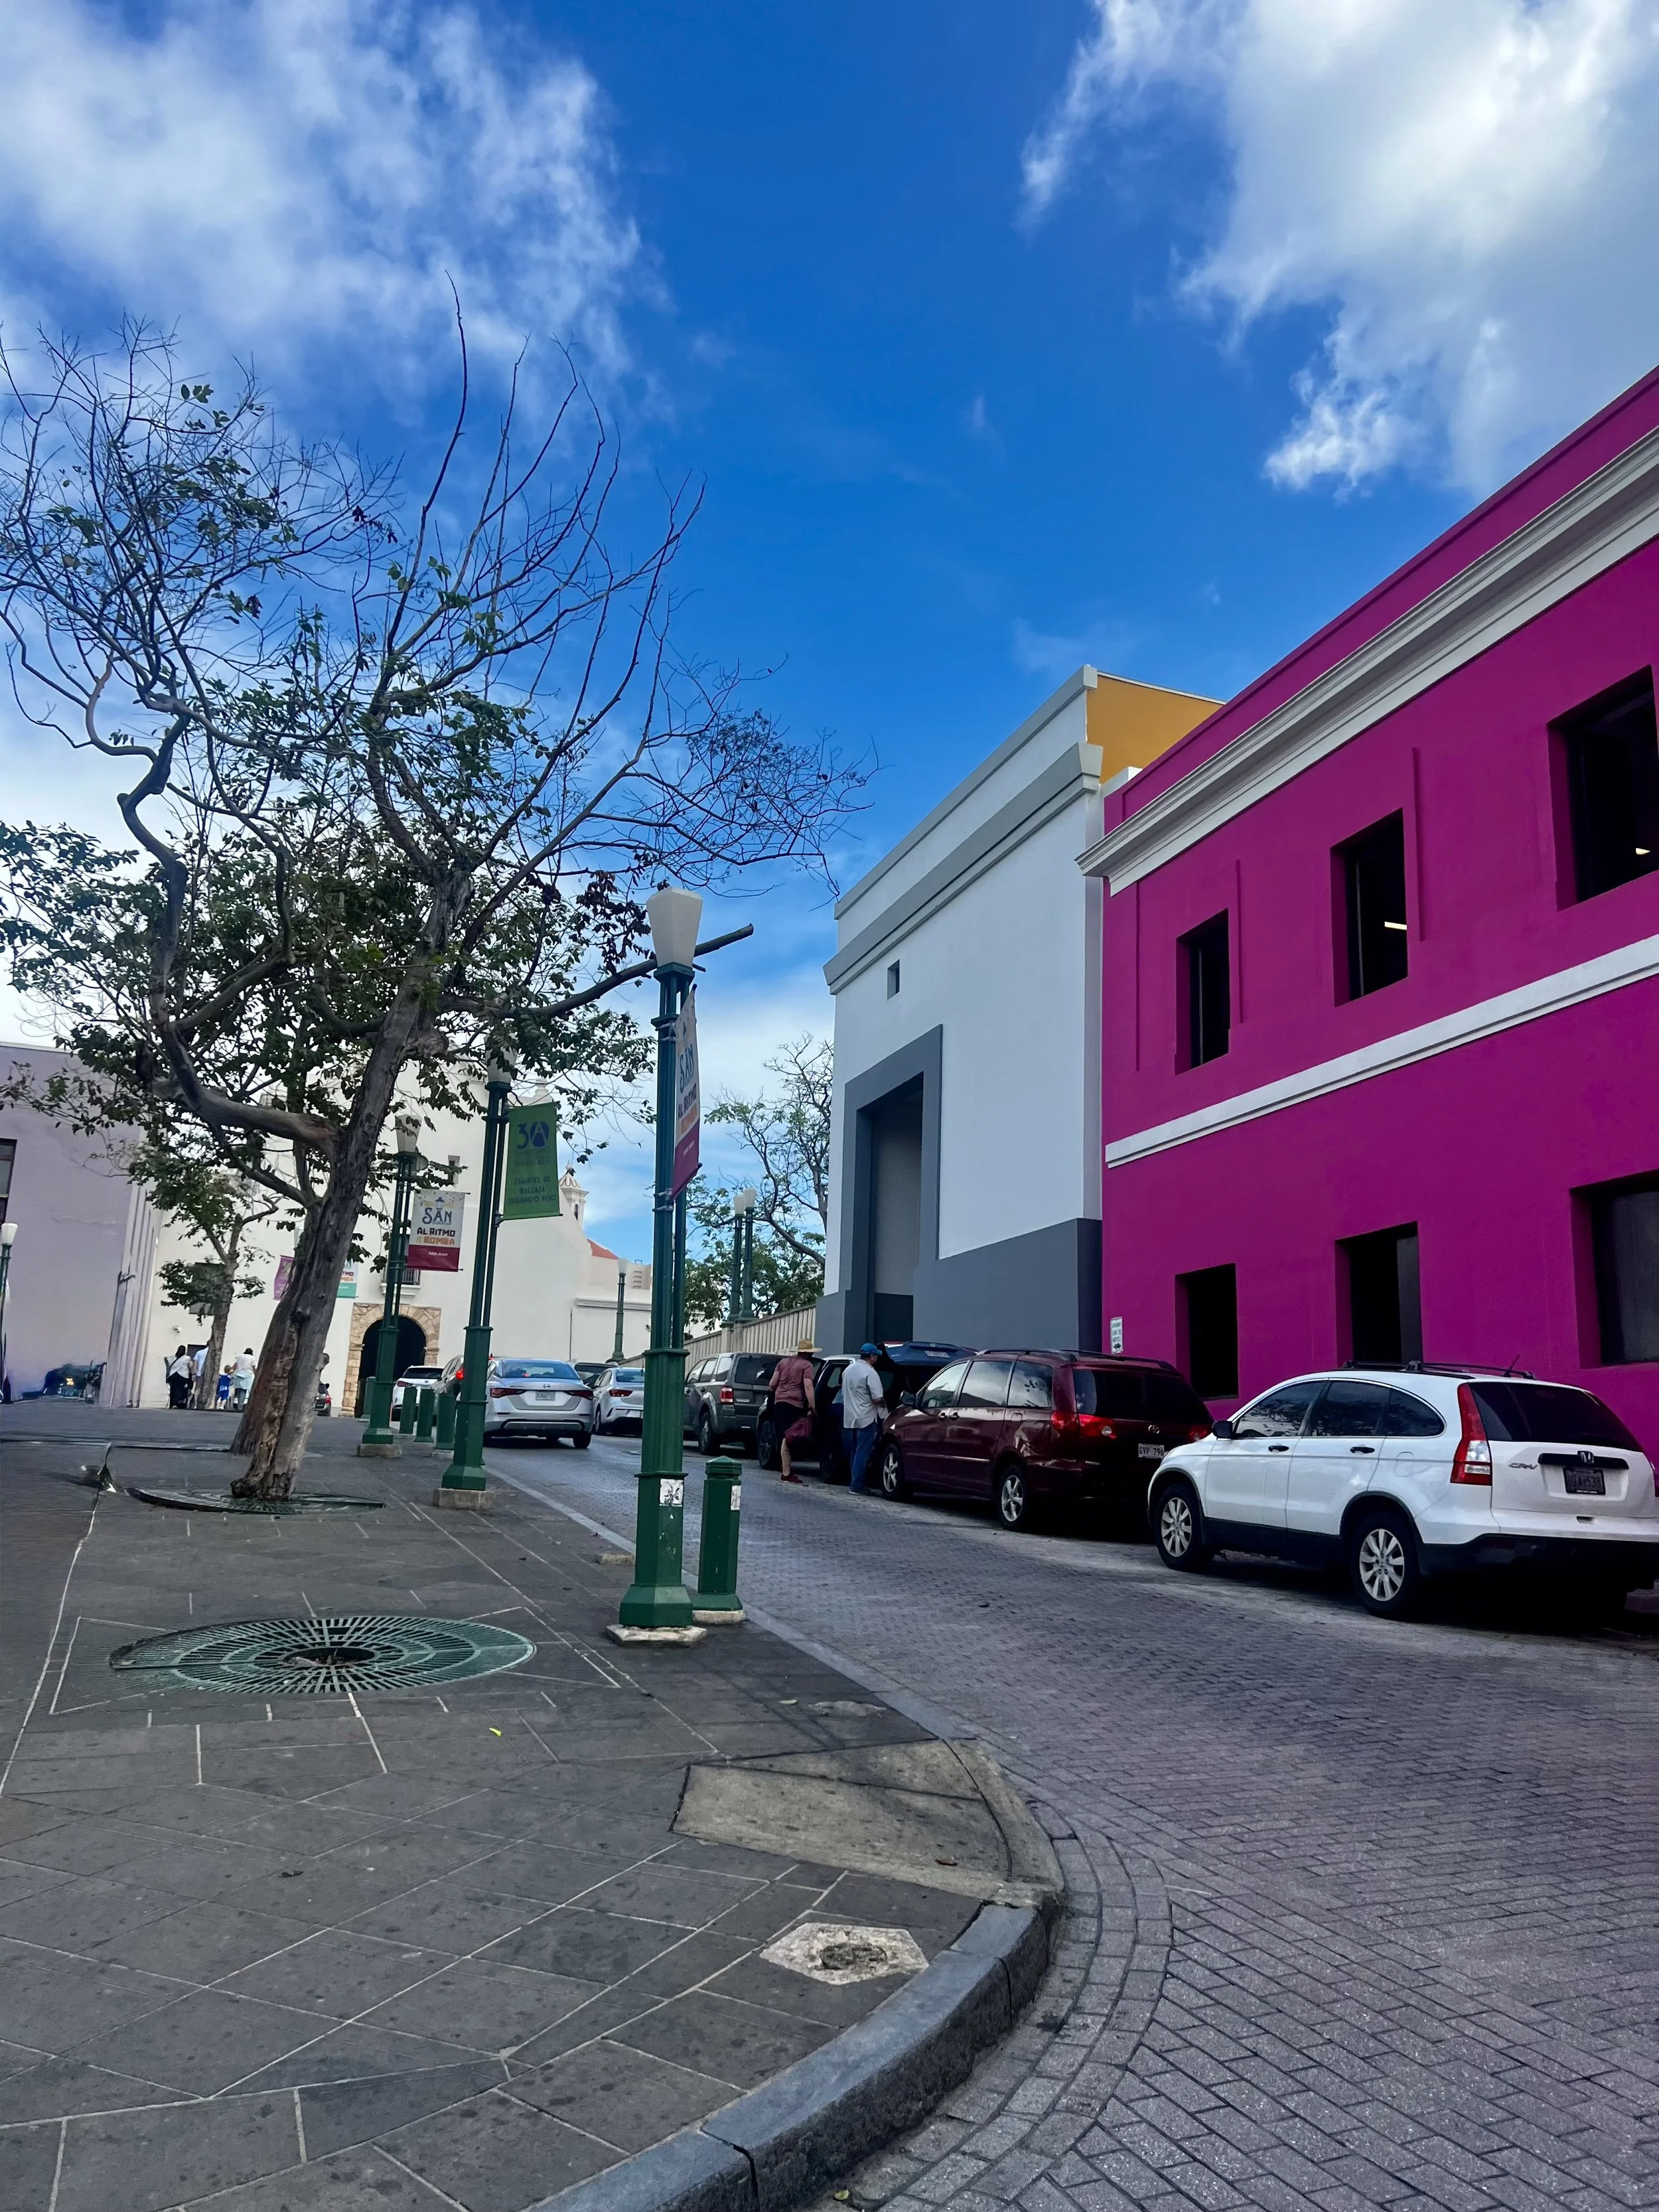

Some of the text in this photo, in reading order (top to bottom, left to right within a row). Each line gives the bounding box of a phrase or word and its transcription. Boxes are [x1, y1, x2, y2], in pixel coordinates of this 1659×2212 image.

[422, 1207, 452, 1224] SAN
[430, 1228, 456, 1236] RITMO
[423, 1236, 455, 1245] BOMBA
